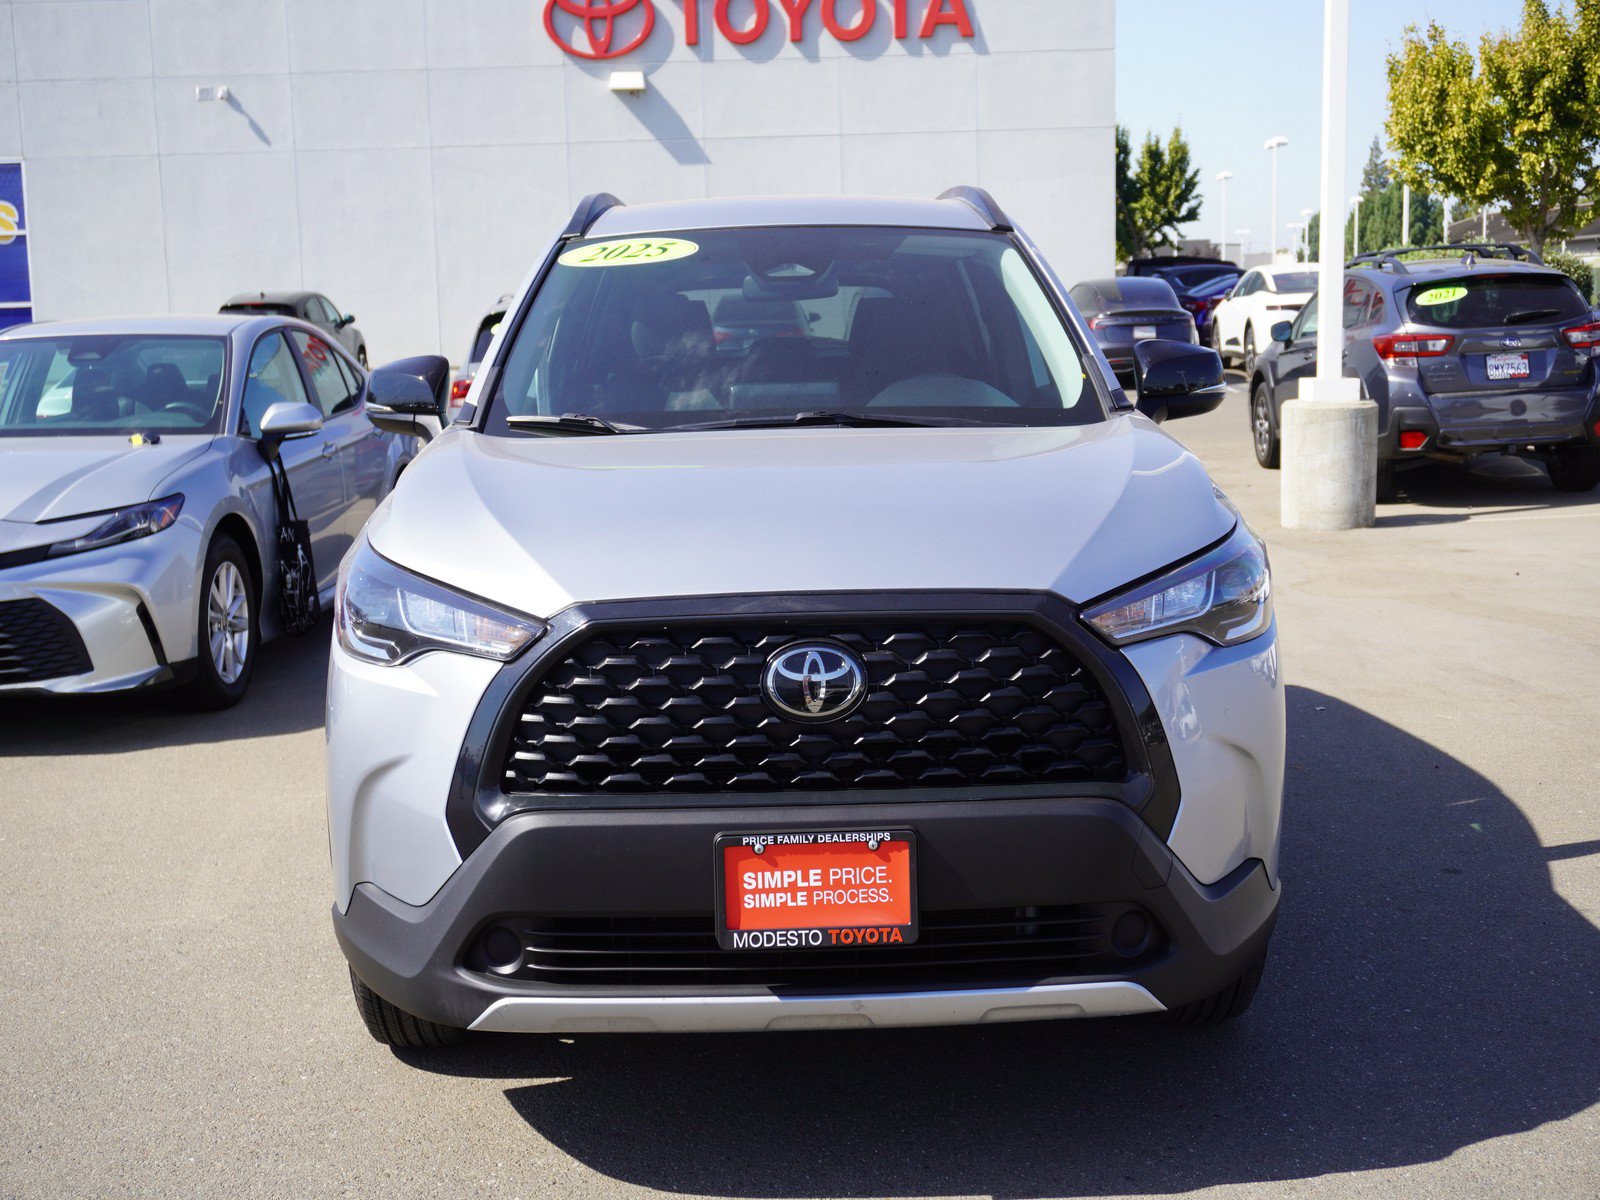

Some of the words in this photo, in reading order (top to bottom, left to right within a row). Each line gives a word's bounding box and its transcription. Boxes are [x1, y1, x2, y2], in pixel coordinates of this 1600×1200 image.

[580, 242, 677, 262] 2025
[1428, 289, 1456, 303] 2021
[742, 835, 774, 846] PRICE
[777, 834, 814, 845] FAMILY
[817, 832, 891, 843] DEALERSHIPS
[743, 869, 822, 890] SIMPLE
[829, 866, 893, 886] PRICE.
[743, 891, 808, 909] SIMPLE
[813, 888, 893, 905] PROCESS.
[733, 930, 823, 949] MODESTO
[828, 927, 903, 945] TOYOTA
